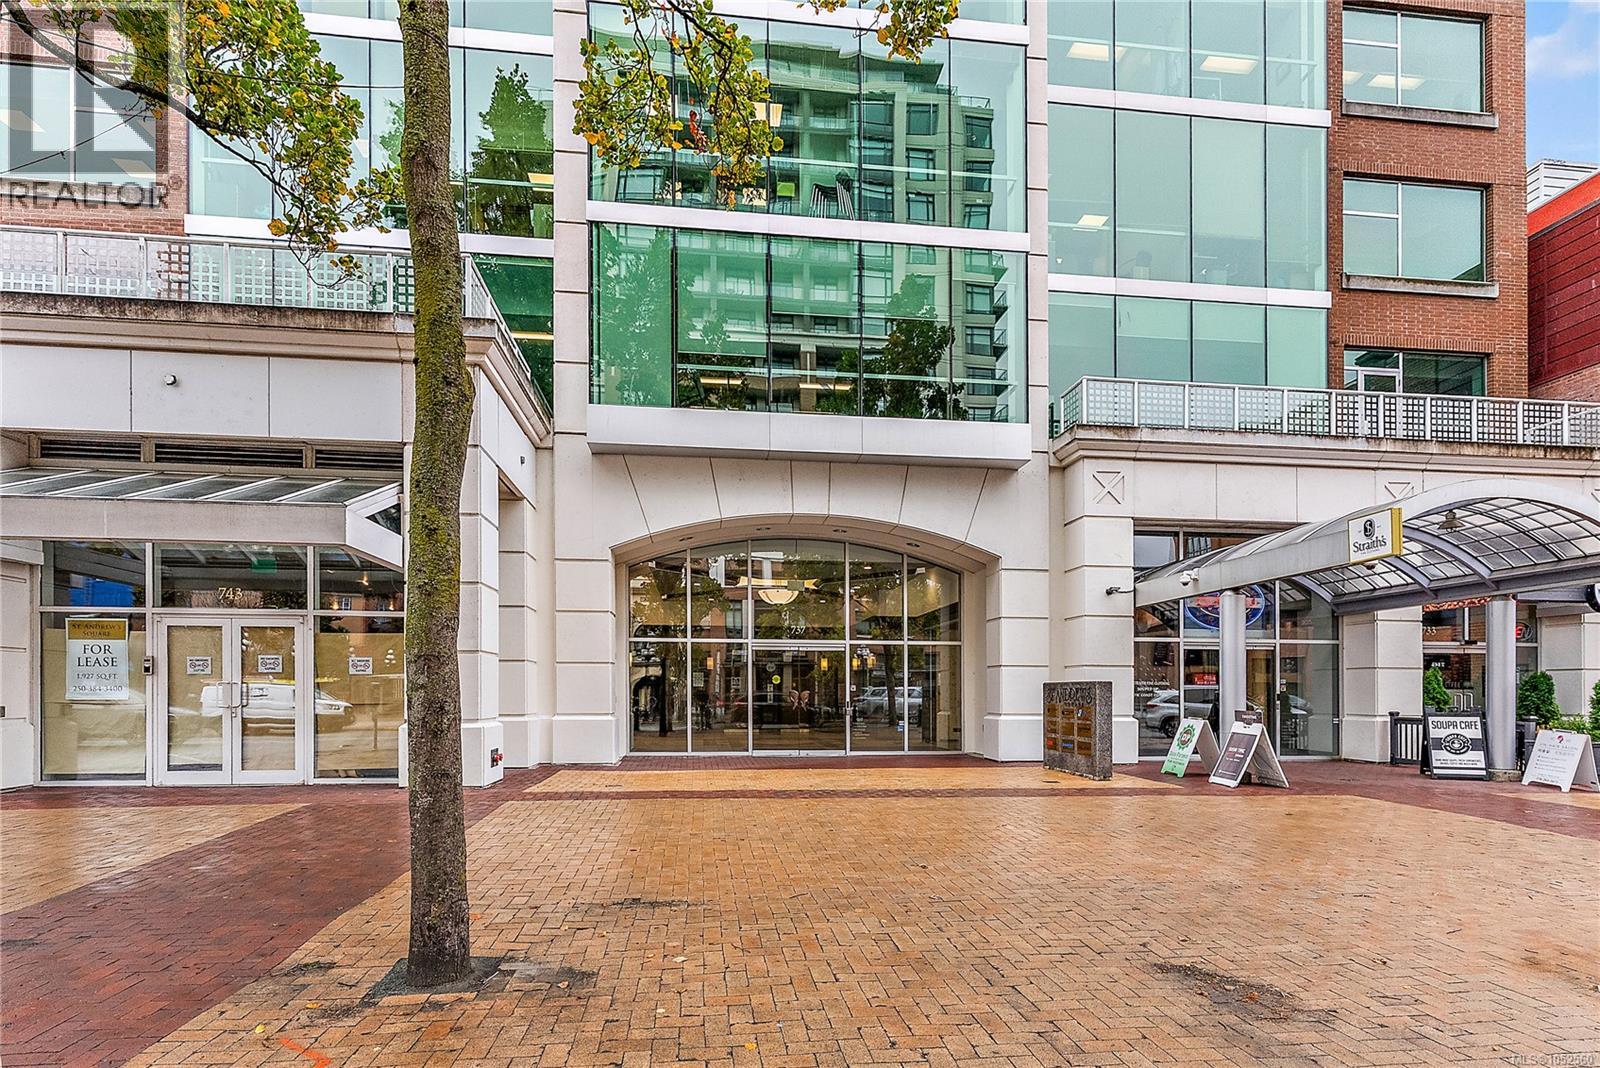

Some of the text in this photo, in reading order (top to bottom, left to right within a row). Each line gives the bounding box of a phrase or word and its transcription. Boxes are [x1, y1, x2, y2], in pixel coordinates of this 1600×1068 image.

[1352, 535, 1388, 553] Straith's
[218, 587, 243, 600] 743
[790, 625, 806, 635] 737
[83, 643, 113, 655] FOR
[77, 656, 118, 668] LEASE
[1431, 720, 1480, 730] SOUPA CAFE
